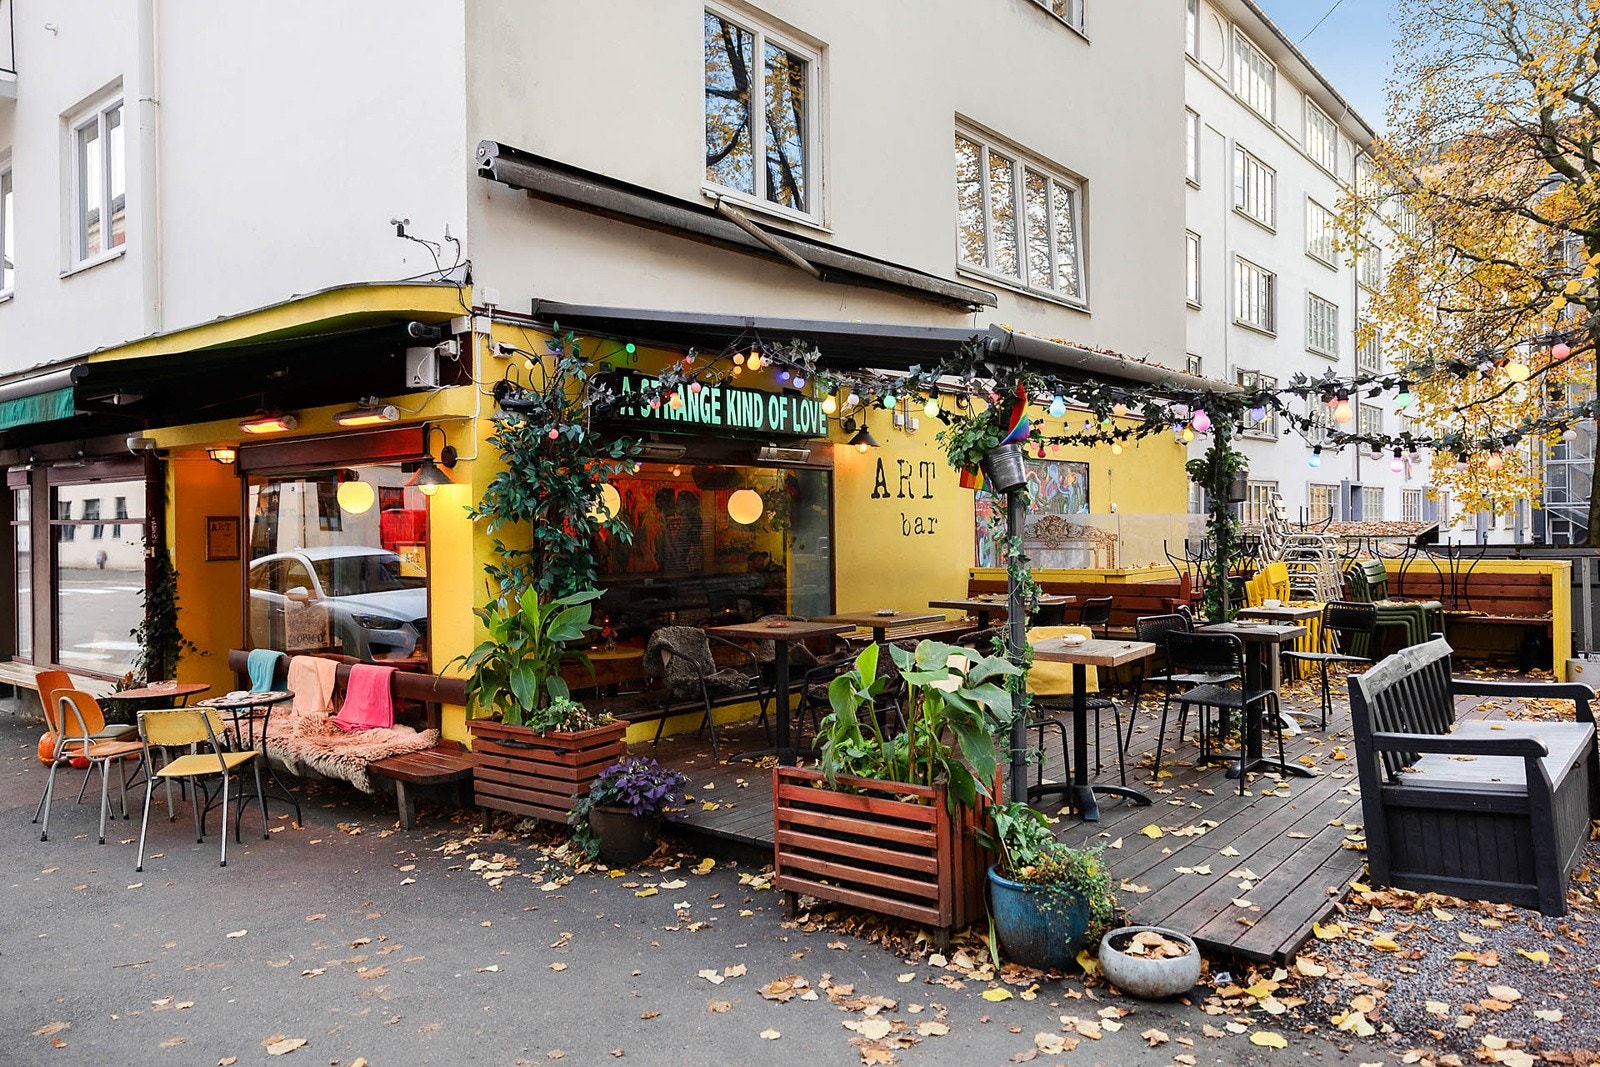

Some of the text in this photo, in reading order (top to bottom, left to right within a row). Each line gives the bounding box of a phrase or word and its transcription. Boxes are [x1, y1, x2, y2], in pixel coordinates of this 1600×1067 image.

[620, 376, 634, 416] A
[726, 389, 764, 428] KIND
[768, 394, 788, 431] OF
[793, 398, 827, 434] LOVE
[871, 457, 936, 499] ART
[901, 512, 938, 537] bar
